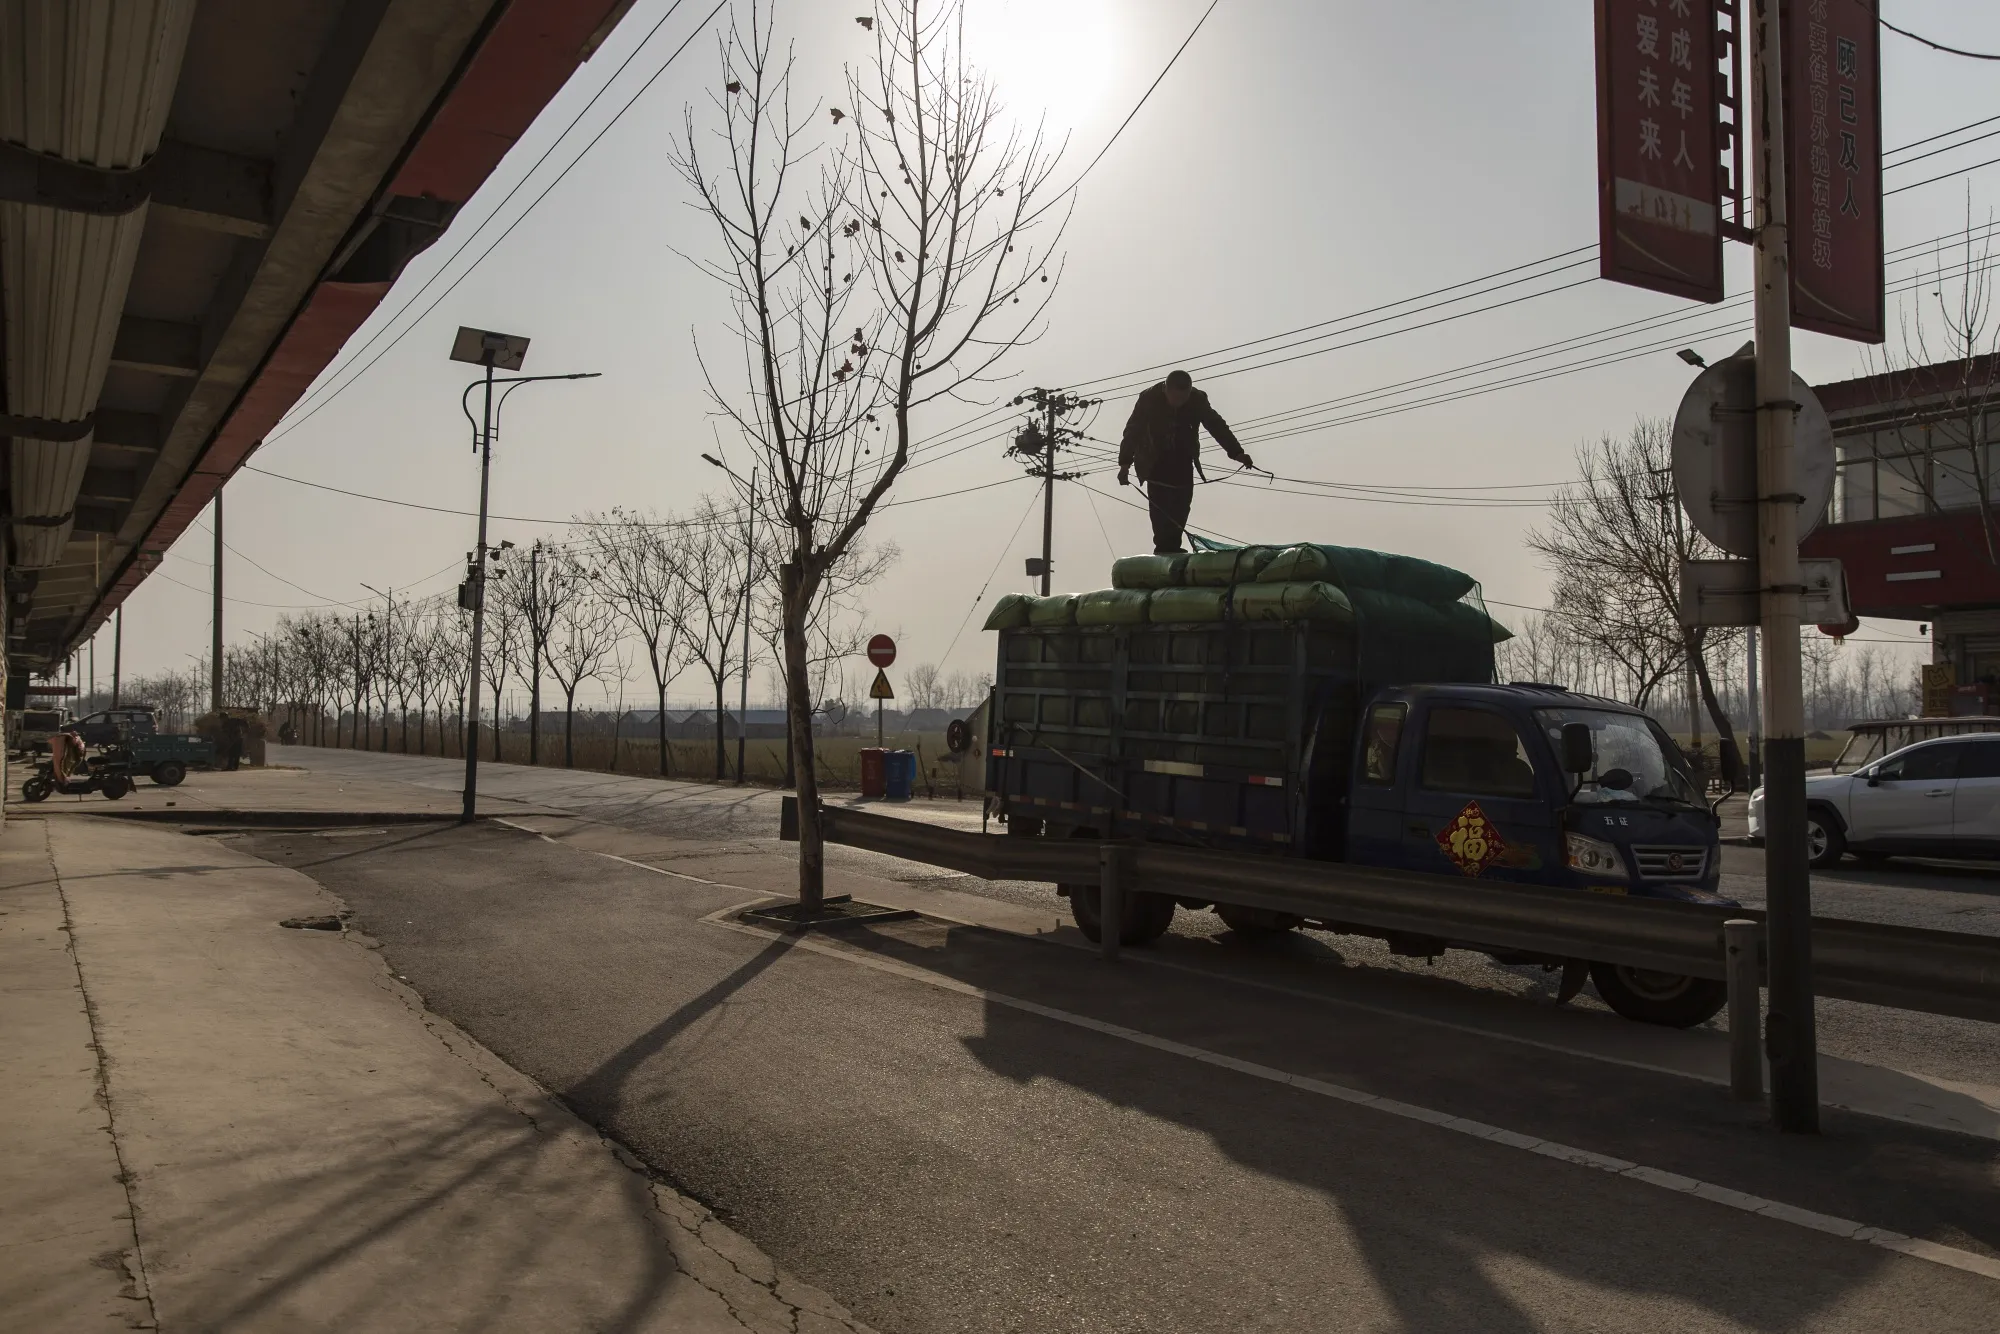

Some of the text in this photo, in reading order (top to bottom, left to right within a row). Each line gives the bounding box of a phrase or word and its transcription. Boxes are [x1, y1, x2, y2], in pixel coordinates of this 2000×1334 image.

[1636, 0, 1661, 160] 爱未来
[1836, 36, 1860, 219] 顾己及人
[1449, 815, 1488, 861] 福
[1603, 816, 1629, 826] 五征
